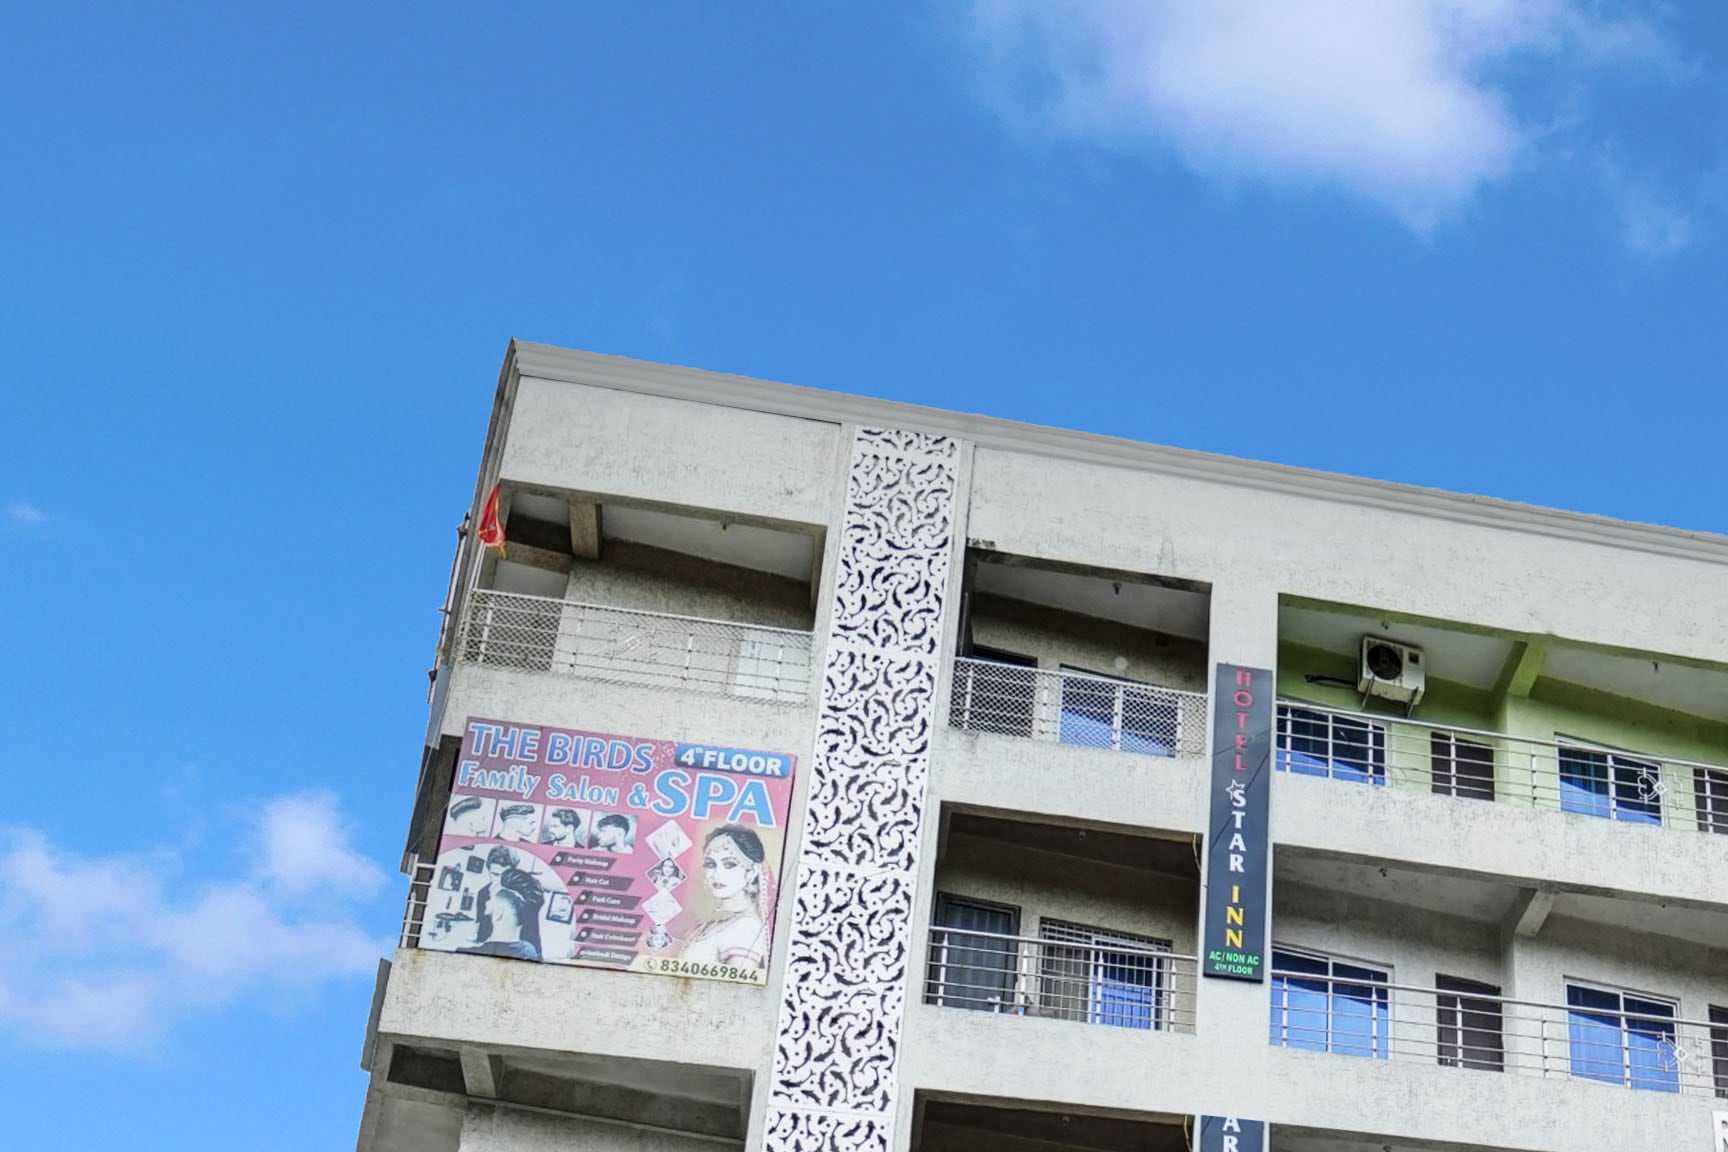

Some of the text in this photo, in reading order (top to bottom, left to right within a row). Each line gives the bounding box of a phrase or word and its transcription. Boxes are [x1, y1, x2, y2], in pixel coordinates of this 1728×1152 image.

[469, 722, 655, 775] THE BIRDS
[1233, 670, 1254, 771] HOTEL
[703, 750, 783, 776] FLOOR
[627, 781, 650, 809] &
[650, 768, 778, 828] SPA
[1228, 788, 1247, 873] STAR
[1225, 884, 1244, 949] INN
[660, 959, 759, 981] 8340669844
[1228, 964, 1253, 975] FLOOR
